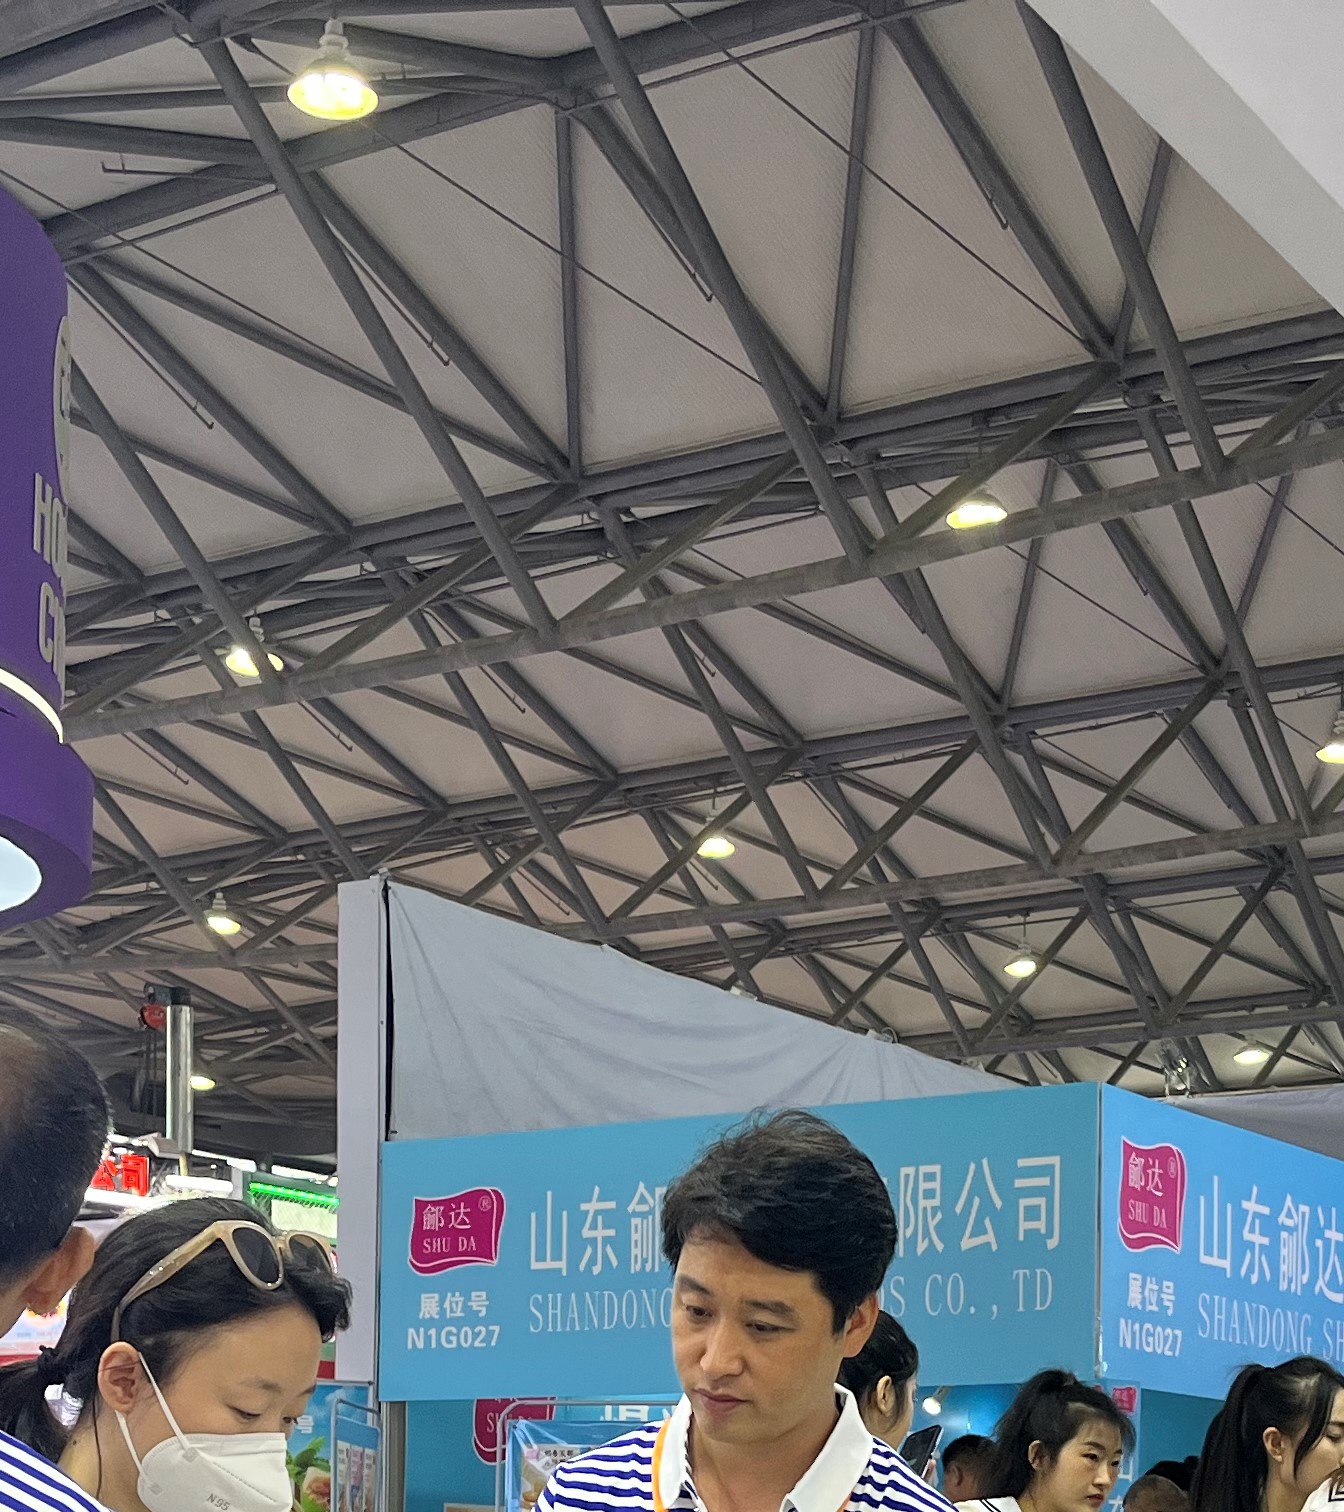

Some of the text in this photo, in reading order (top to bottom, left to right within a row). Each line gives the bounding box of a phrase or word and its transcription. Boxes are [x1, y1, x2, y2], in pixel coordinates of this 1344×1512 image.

[1128, 1199, 1168, 1229] SHU DA
[422, 1236, 477, 1254] SHU DA
[418, 1291, 490, 1320] 展位号
[1127, 1271, 1177, 1317] 展位号
[407, 1325, 500, 1350] N1G027
[1118, 1317, 1183, 1358] N1G027
[1197, 1291, 1312, 1354] SHANDONG
